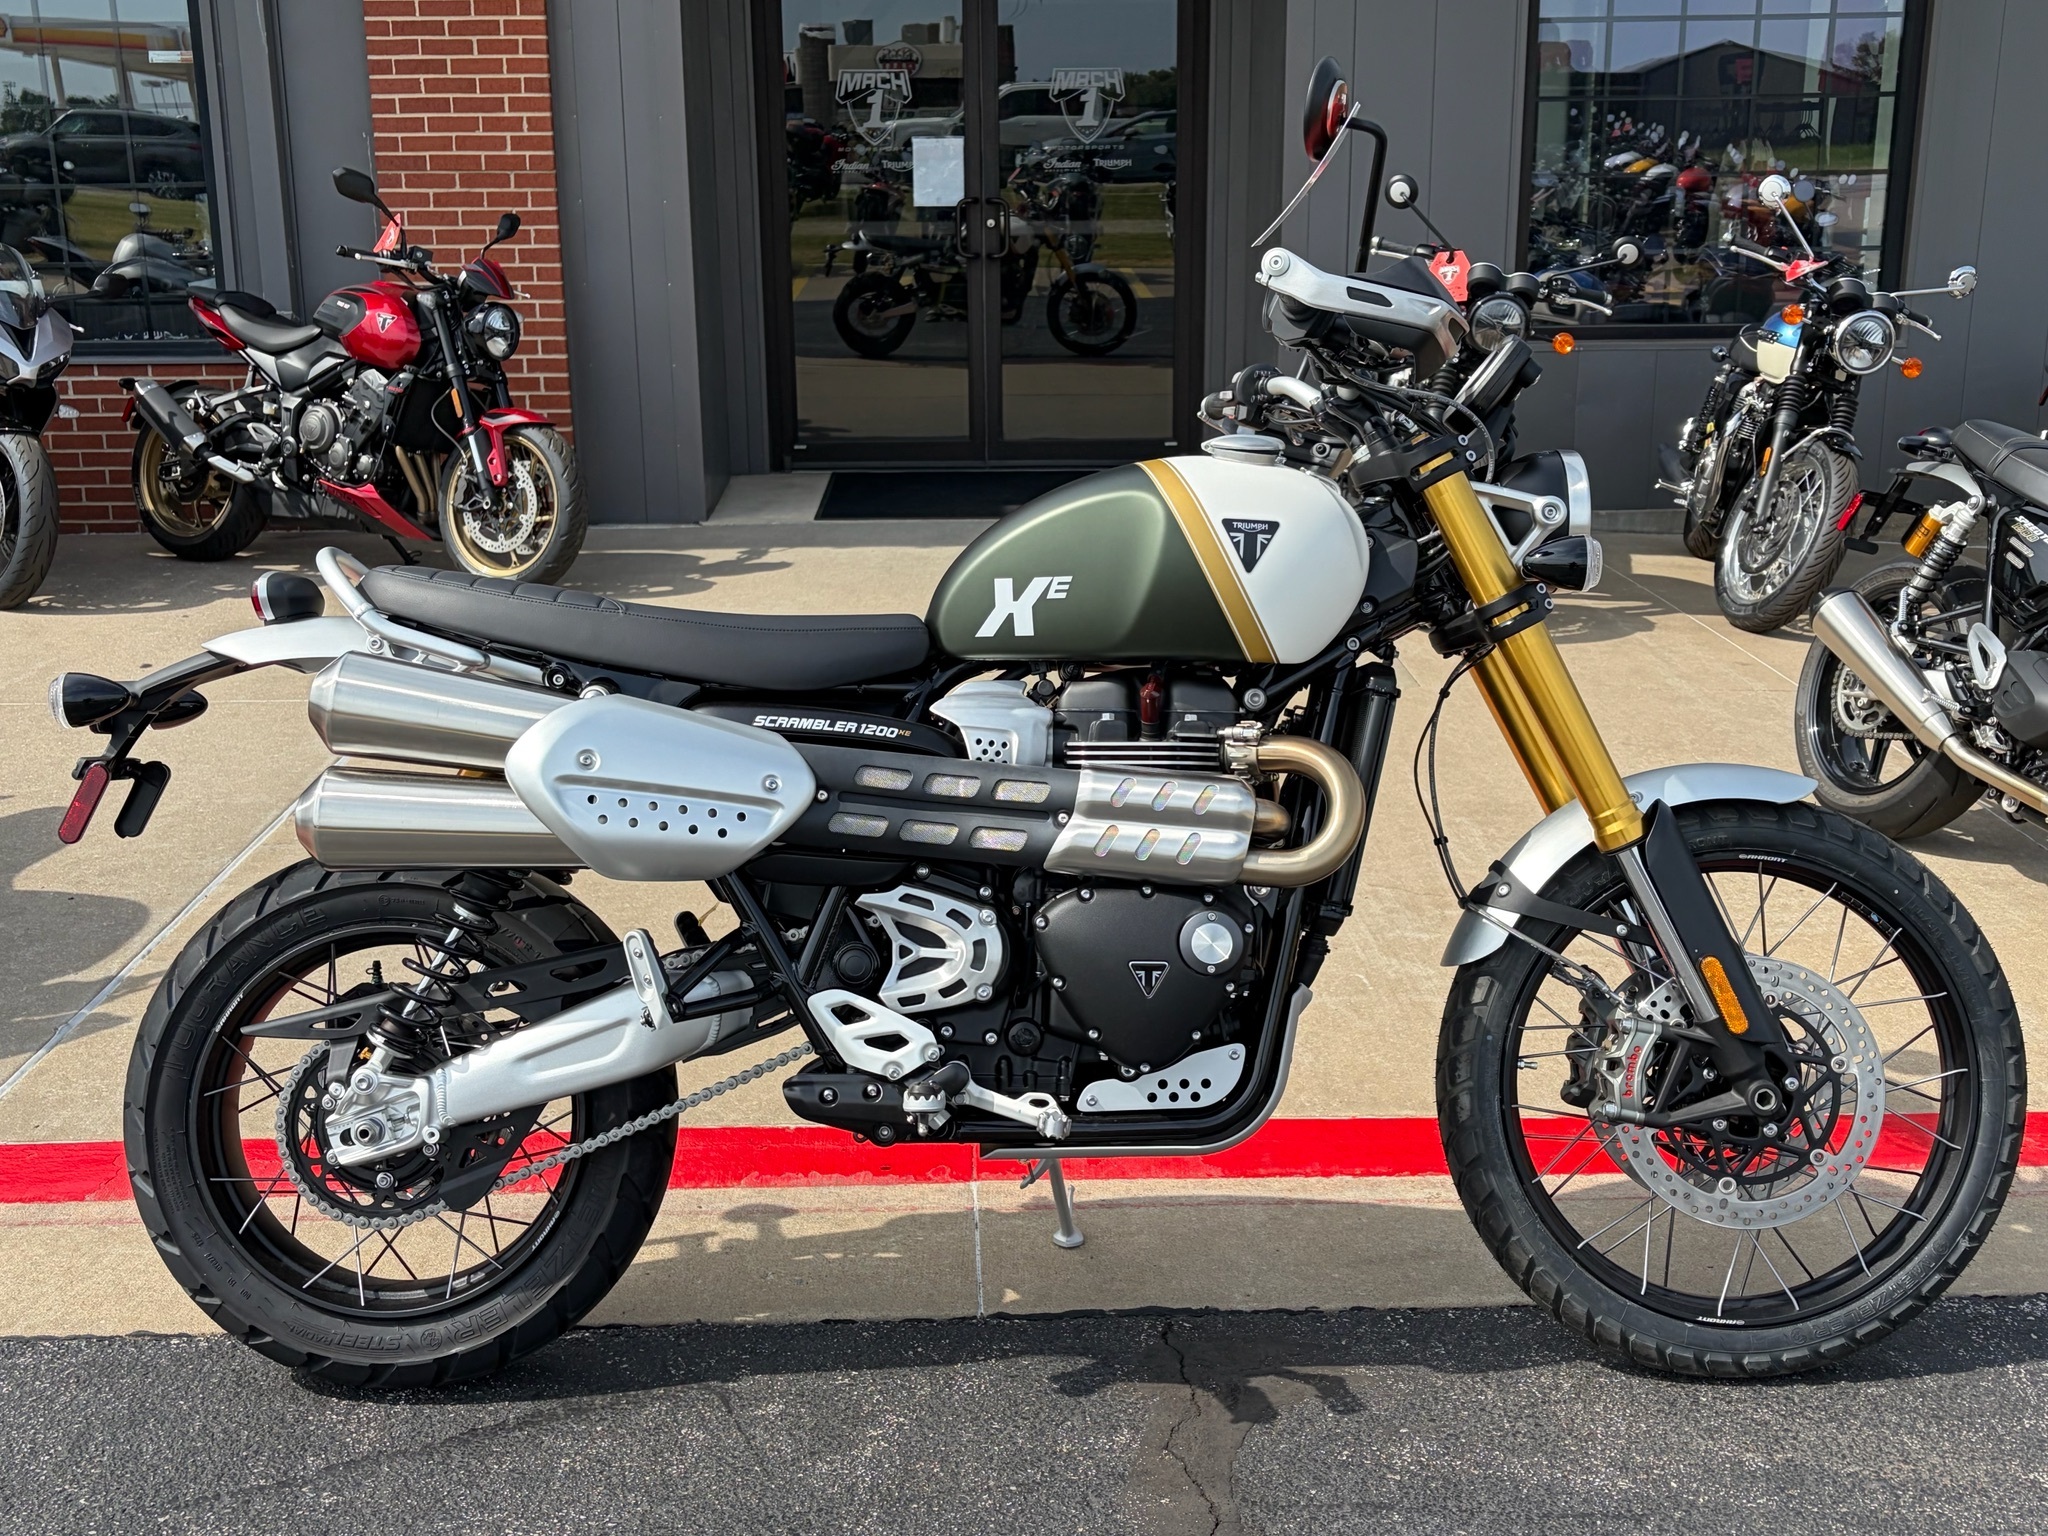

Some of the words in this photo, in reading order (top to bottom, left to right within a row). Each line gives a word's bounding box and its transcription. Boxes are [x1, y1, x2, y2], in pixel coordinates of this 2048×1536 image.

[840, 72, 908, 97] MACH
[1053, 71, 1122, 95] MACH
[863, 89, 887, 127] 1
[1075, 87, 1099, 126] 1
[831, 158, 870, 171] Indian
[881, 160, 915, 171] TRIUMP
[1043, 157, 1082, 169] Indian
[1093, 158, 1132, 170] TRIUMPH
[1232, 521, 1268, 532] TRIUMPH
[2011, 522, 2040, 542] 1200
[2014, 515, 2044, 536] SPEED
[753, 715, 858, 734] SCRAMBLER
[859, 723, 899, 738] 1200
[162, 906, 328, 1072] TOURANCE
[1622, 1046, 1642, 1099] brembo
[1813, 1256, 1936, 1339] METZELER
[331, 1330, 402, 1350] STEEL
